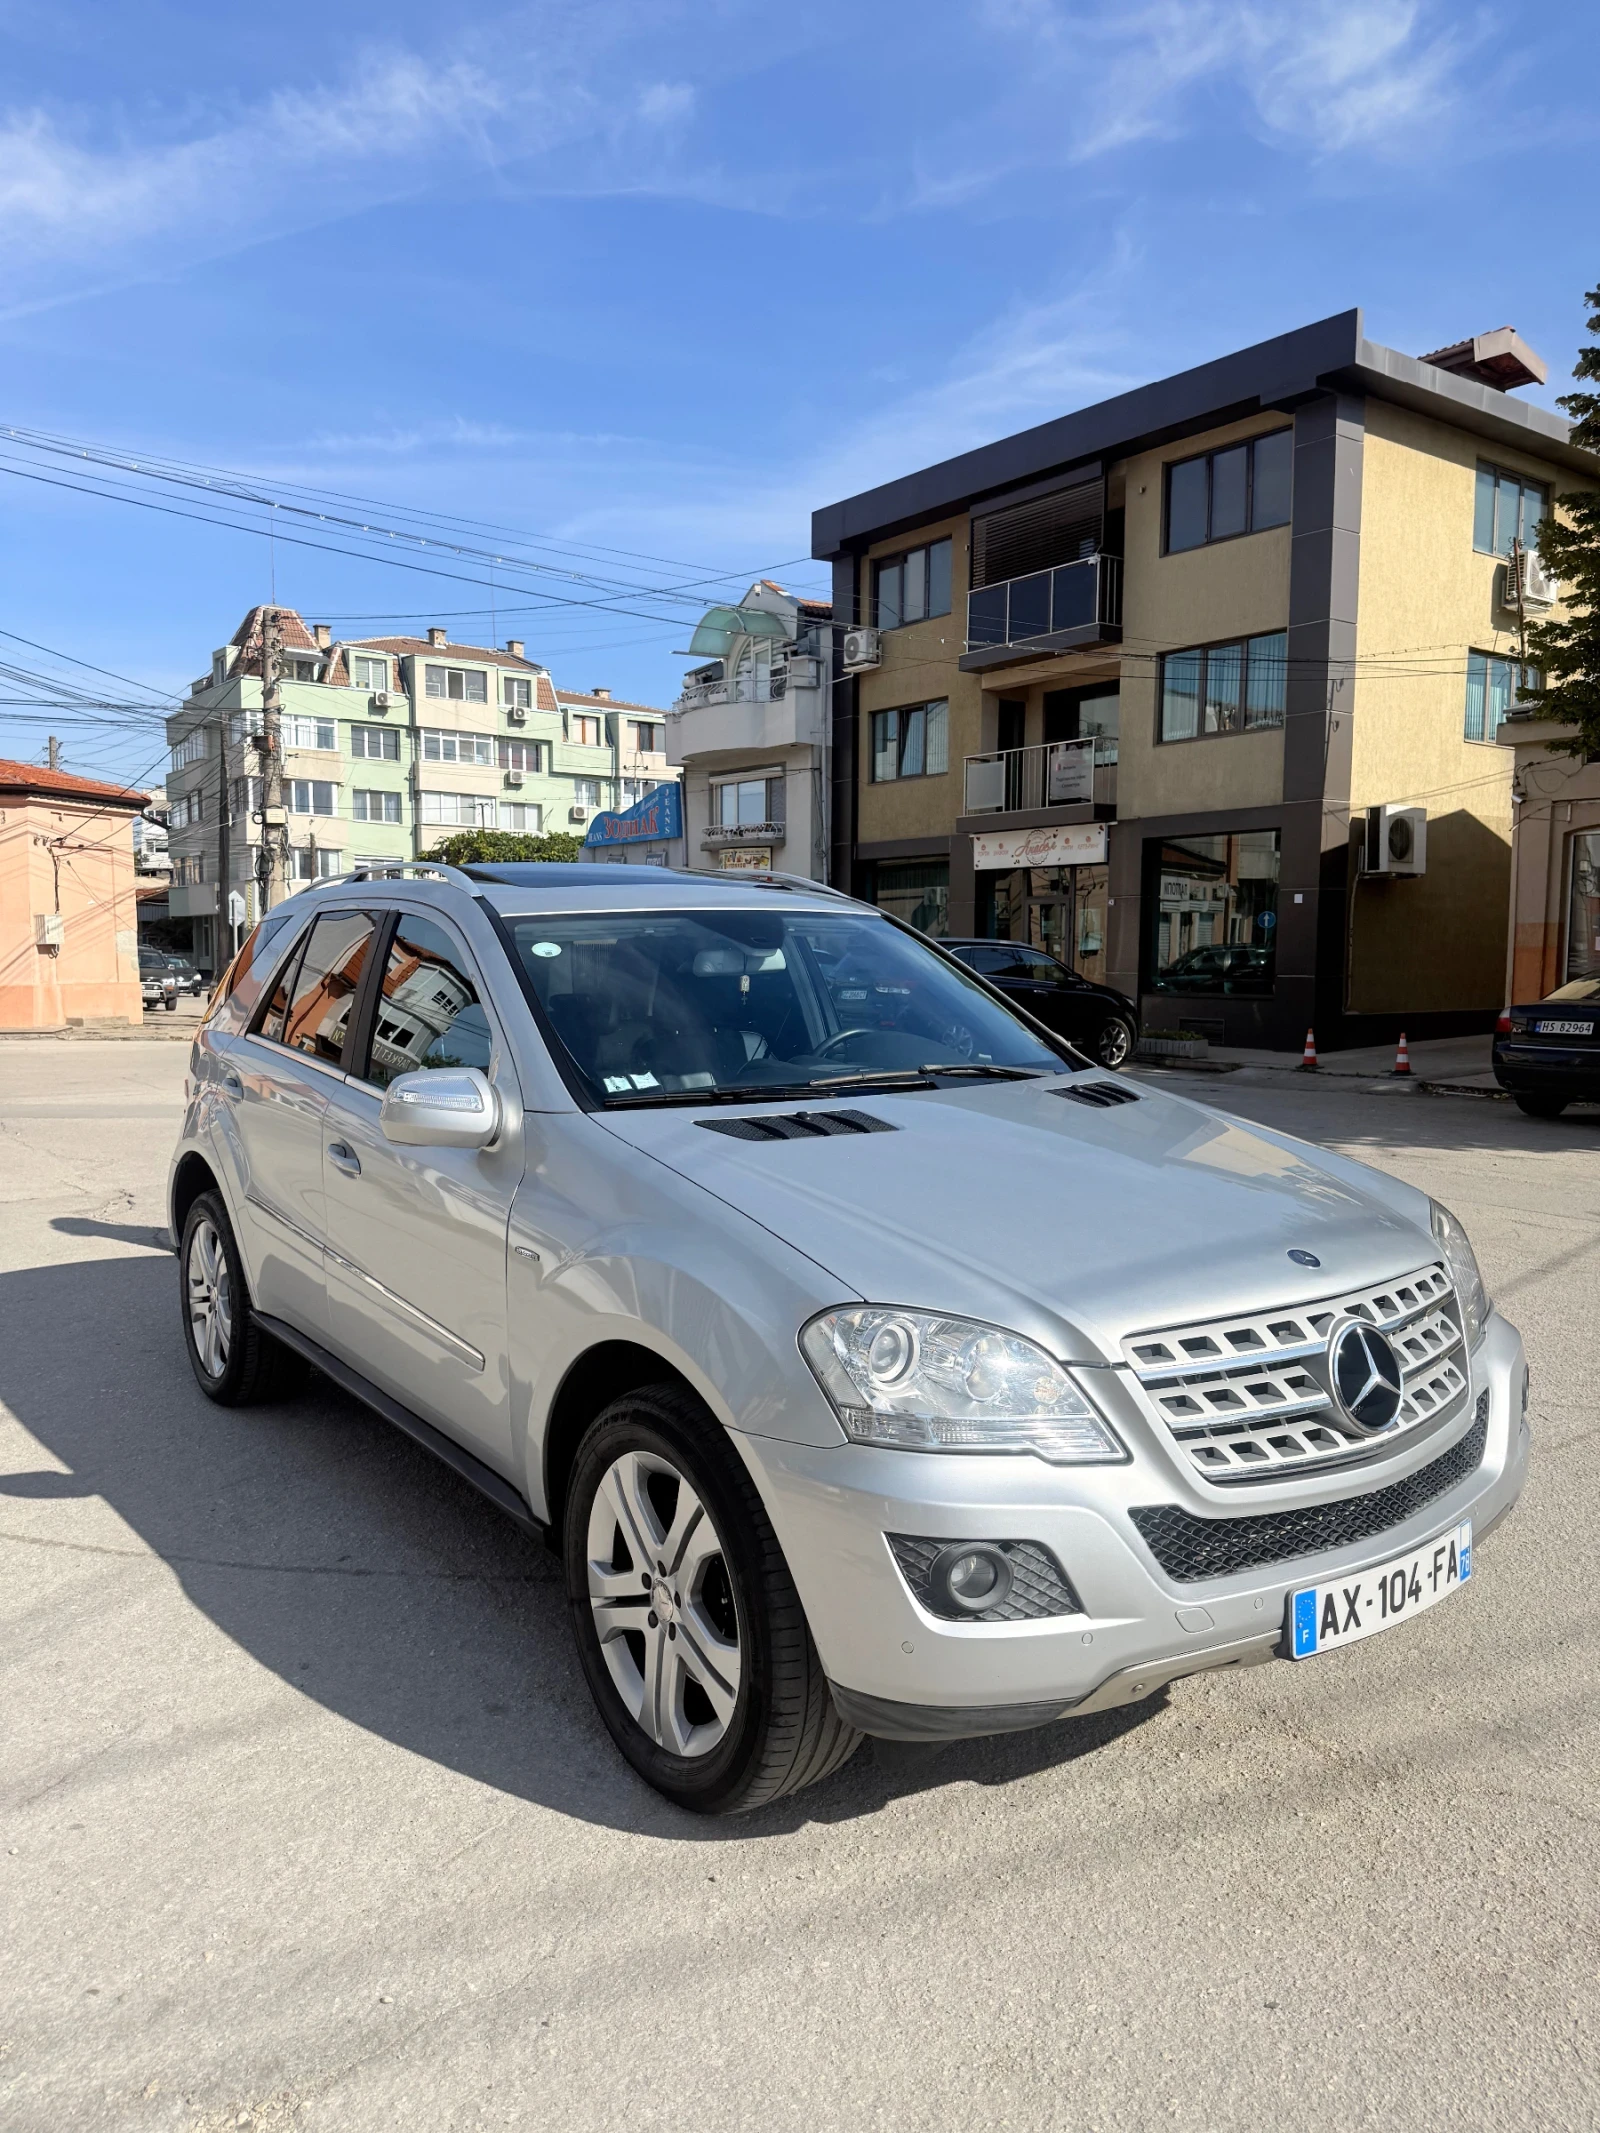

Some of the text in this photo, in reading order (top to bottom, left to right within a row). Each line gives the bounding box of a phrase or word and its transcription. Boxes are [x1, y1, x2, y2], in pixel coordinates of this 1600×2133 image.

[603, 806, 659, 841] ЗОДИАК
[588, 832, 603, 843] JEANS
[1541, 1022, 1592, 1033] HS 82964
[1302, 1540, 1471, 1644] F AX-104-FA 78
